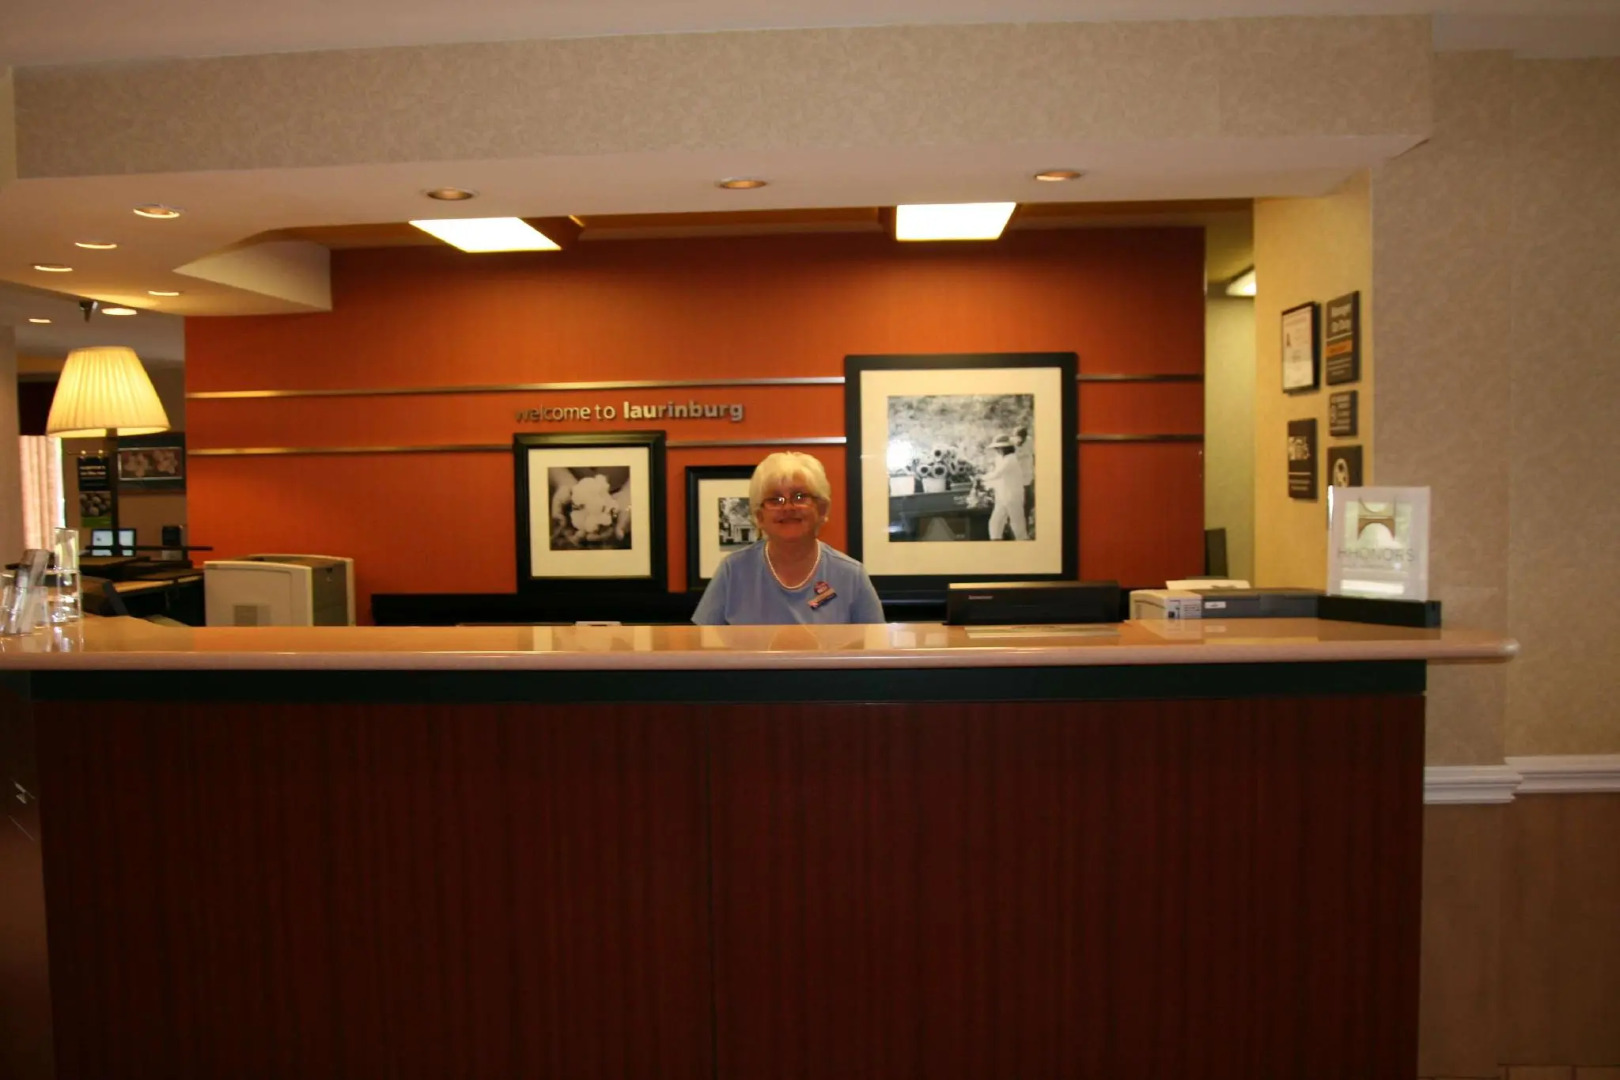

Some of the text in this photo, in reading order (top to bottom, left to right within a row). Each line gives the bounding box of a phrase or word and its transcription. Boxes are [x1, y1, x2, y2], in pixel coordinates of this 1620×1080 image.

[515, 400, 744, 423] welcome to laurinburg
